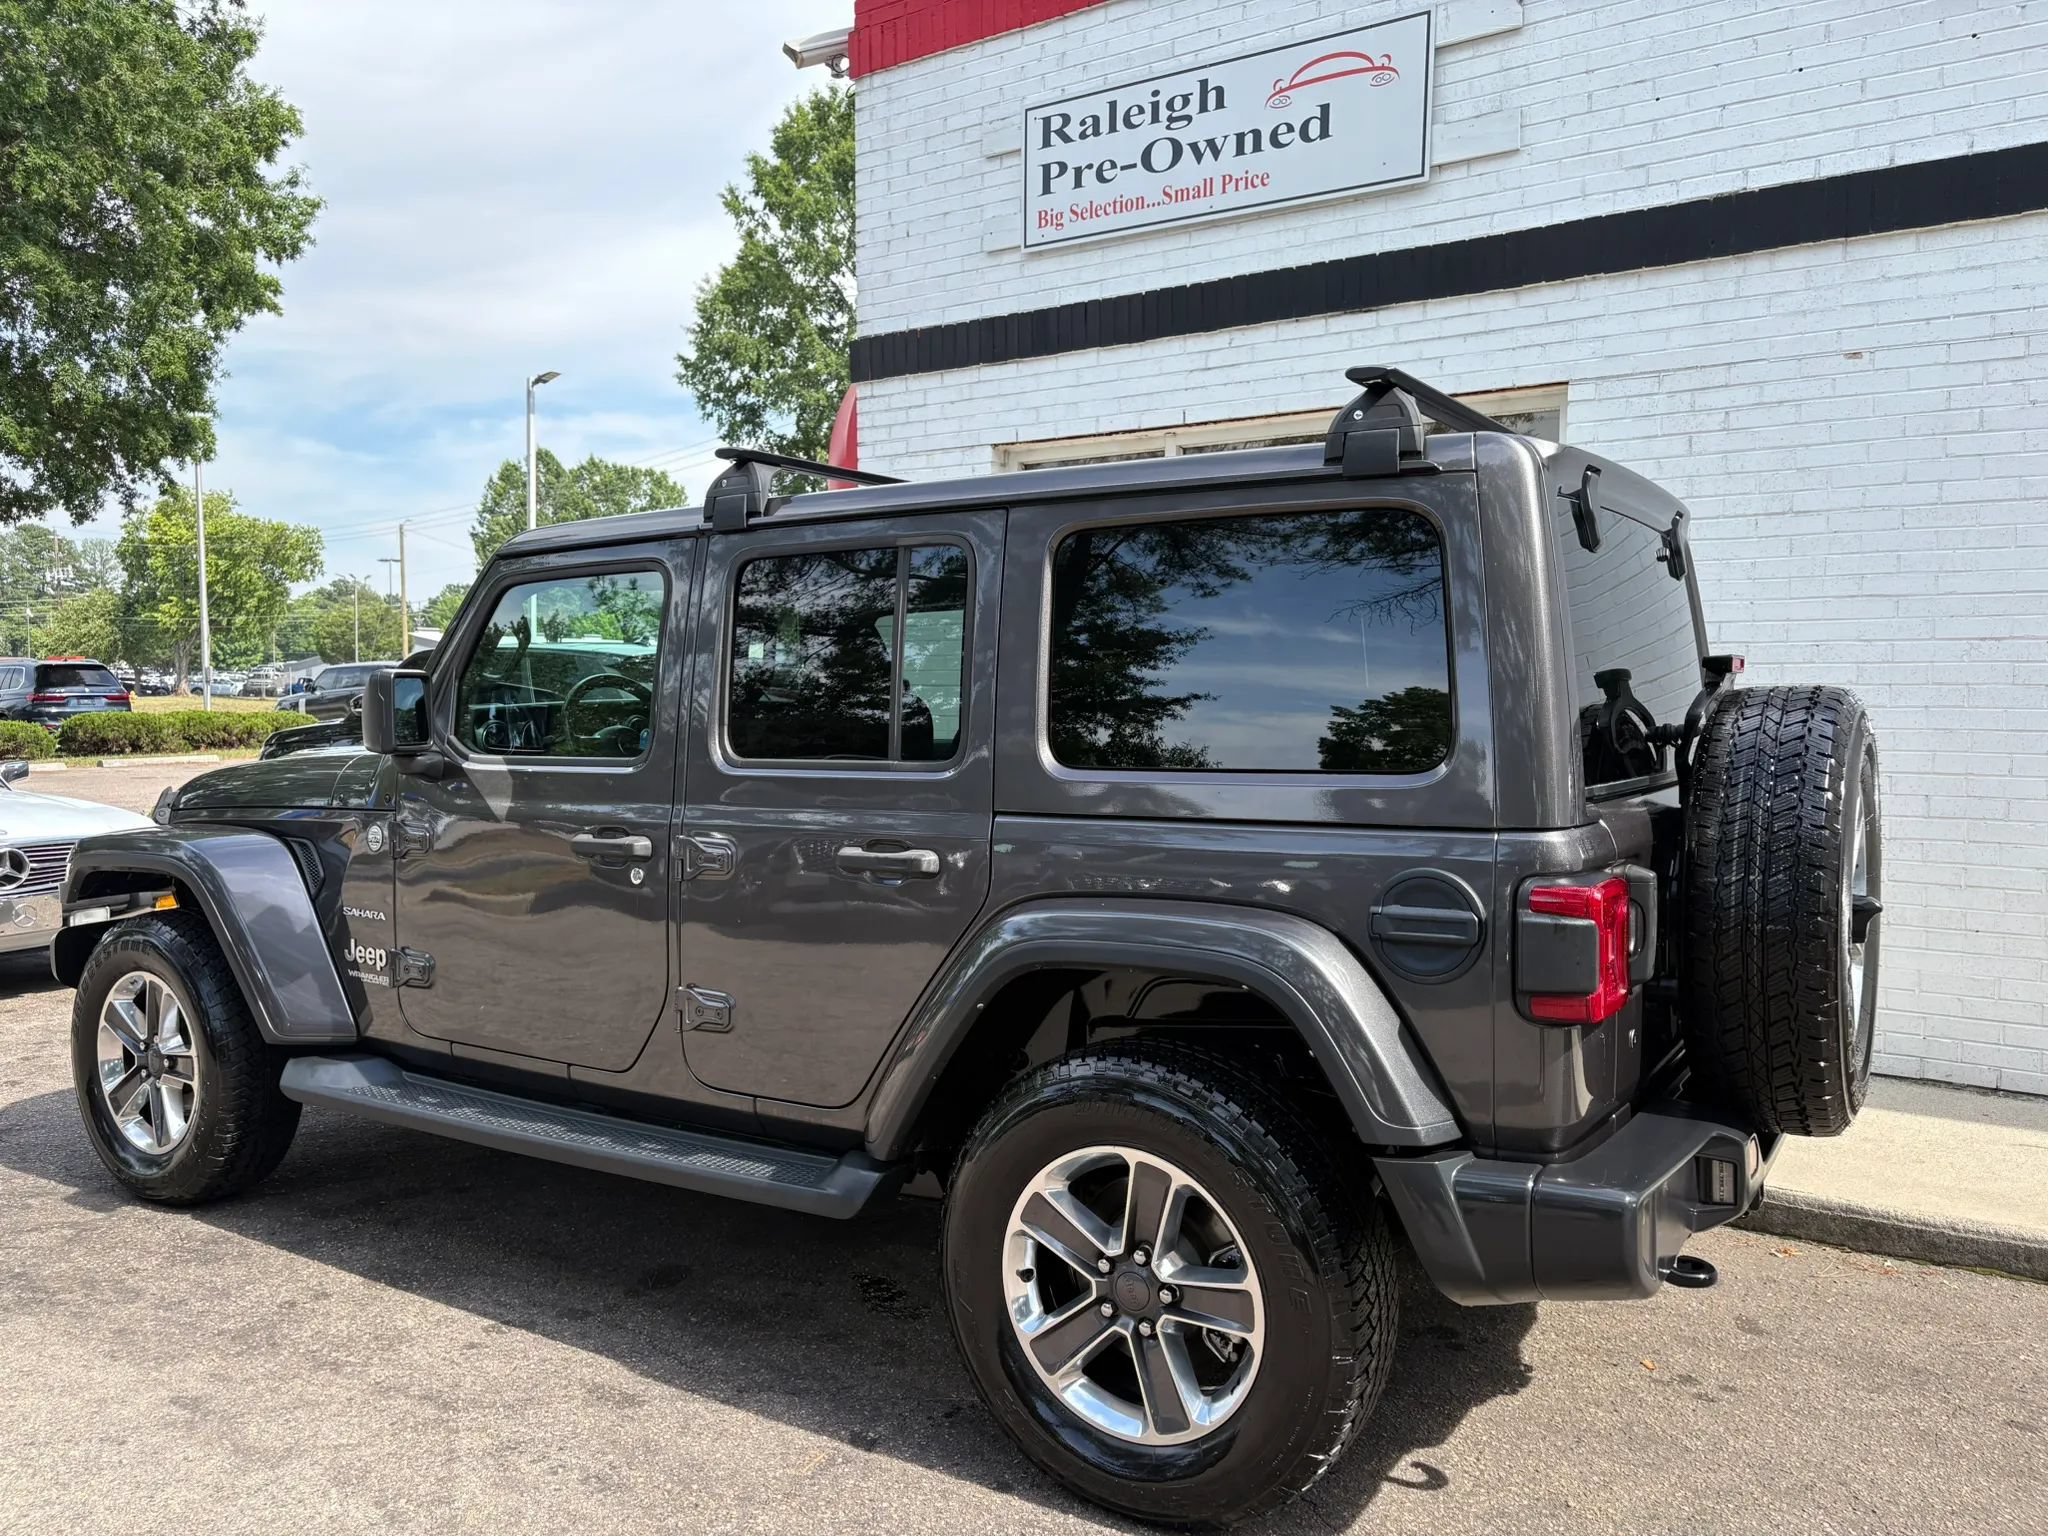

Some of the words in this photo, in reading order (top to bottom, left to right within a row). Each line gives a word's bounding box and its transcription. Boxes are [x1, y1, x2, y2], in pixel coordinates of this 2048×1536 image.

[1037, 78, 1228, 151] Raleigh
[1037, 103, 1333, 197] Pre-Owned
[1037, 208, 1064, 231] Big
[1221, 170, 1270, 194] Price
[343, 906, 386, 921] SAHARA
[344, 938, 387, 972] Jeep
